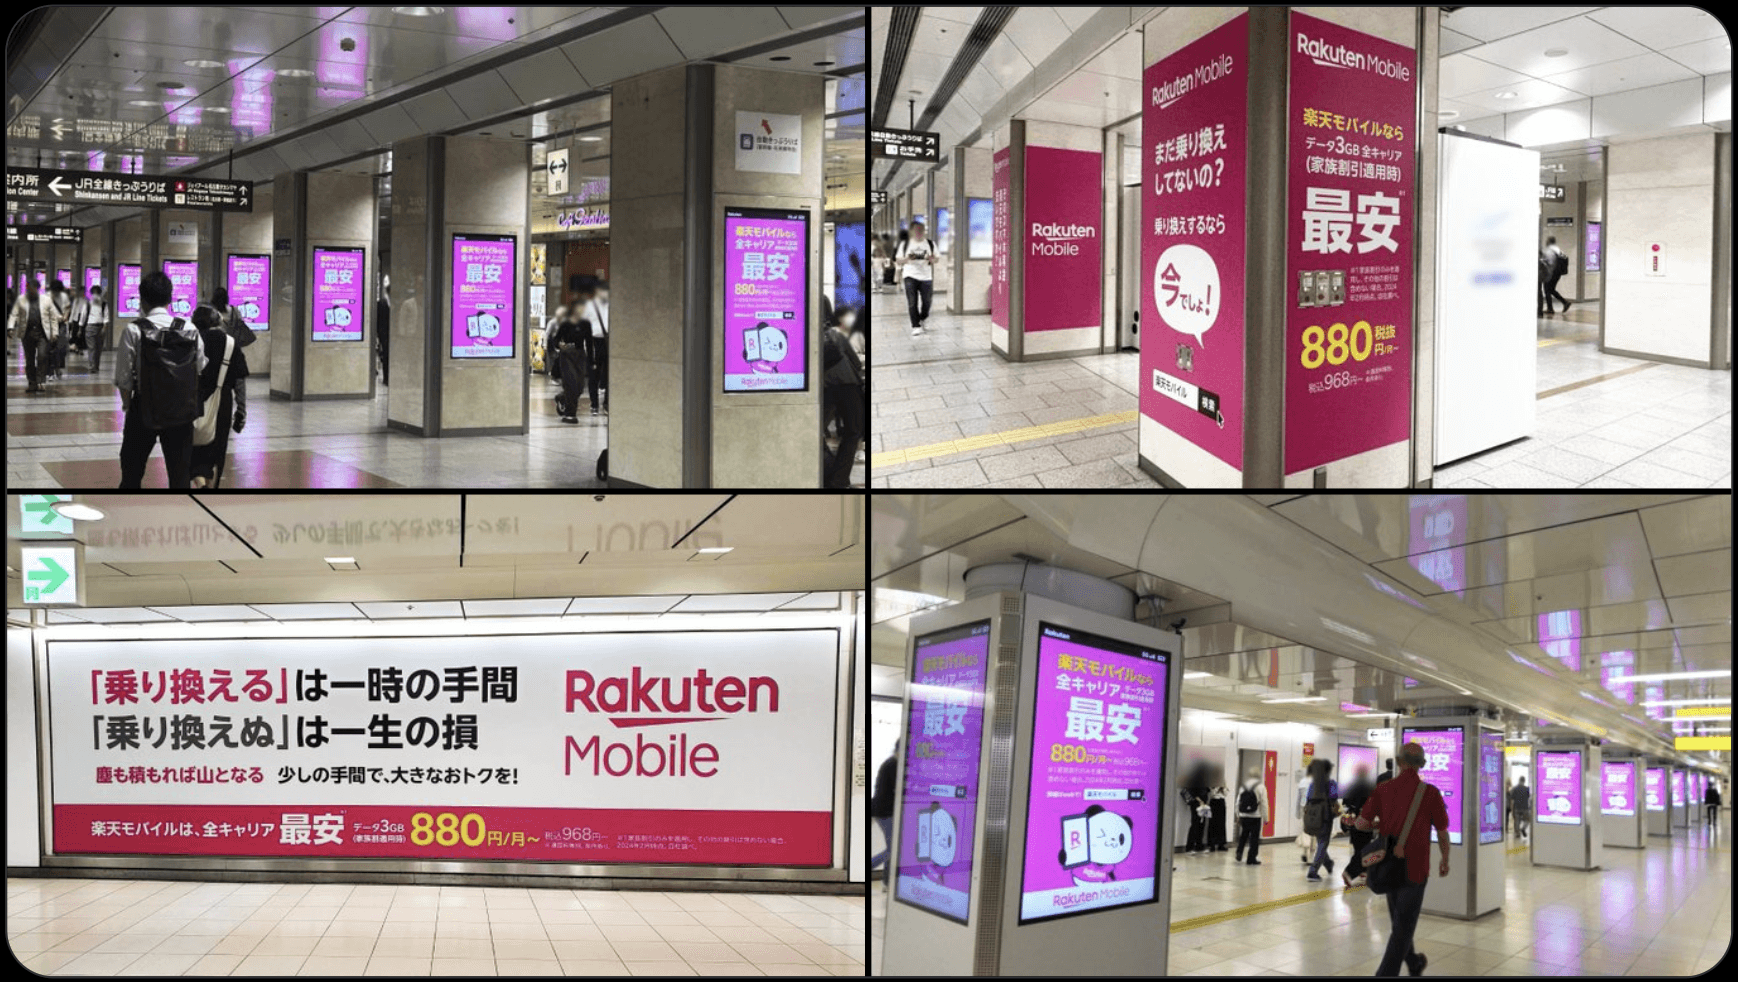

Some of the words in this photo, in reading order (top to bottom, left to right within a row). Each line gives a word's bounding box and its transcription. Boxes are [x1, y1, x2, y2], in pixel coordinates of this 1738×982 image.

[1297, 32, 1365, 70] Rakuten
[1366, 53, 1410, 81] Mobile
[1152, 73, 1194, 107] Rakuten
[1194, 53, 1233, 89] Mobile
[1303, 107, 1404, 141] 楽天モバイルなら
[1155, 123, 1227, 165] まだ乗り換え
[1306, 136, 1360, 156] データ3GB
[1361, 145, 1402, 161] 全キャリア
[75, 178, 166, 193] JR全線きっぷうりば
[1155, 157, 1225, 195] してないの?
[1305, 155, 1402, 182] (家族割引適用時)
[1032, 222, 1095, 238] Rakuten
[1154, 214, 1226, 236] 乗り換えするなら
[1301, 186, 1401, 254] 最安
[1032, 242, 1079, 256] Mobile
[325, 269, 353, 284] 最安
[466, 263, 502, 283] 最安
[742, 252, 790, 281] 最安
[1160, 262, 1212, 316] 今でしょ!
[1300, 320, 1373, 369] 880
[91, 666, 518, 705] 「乗り換える」は一時の手間
[1055, 673, 1121, 697] 全キャリア
[1057, 653, 1154, 687] 楽天モバイルなら
[565, 666, 779, 713] Rakuten
[93, 713, 479, 750] 「乗り換えぬ」は一生の損
[1065, 695, 1142, 745] 最安
[564, 733, 720, 777] Mobile
[95, 765, 264, 784] 塵も積もれば山となる
[277, 766, 518, 785] 少しの手間で、大きなおトクを!
[91, 820, 276, 838] 楽天モバイルは、全キャリア
[279, 812, 345, 845] 最安
[1053, 891, 1099, 907] Rakuten
